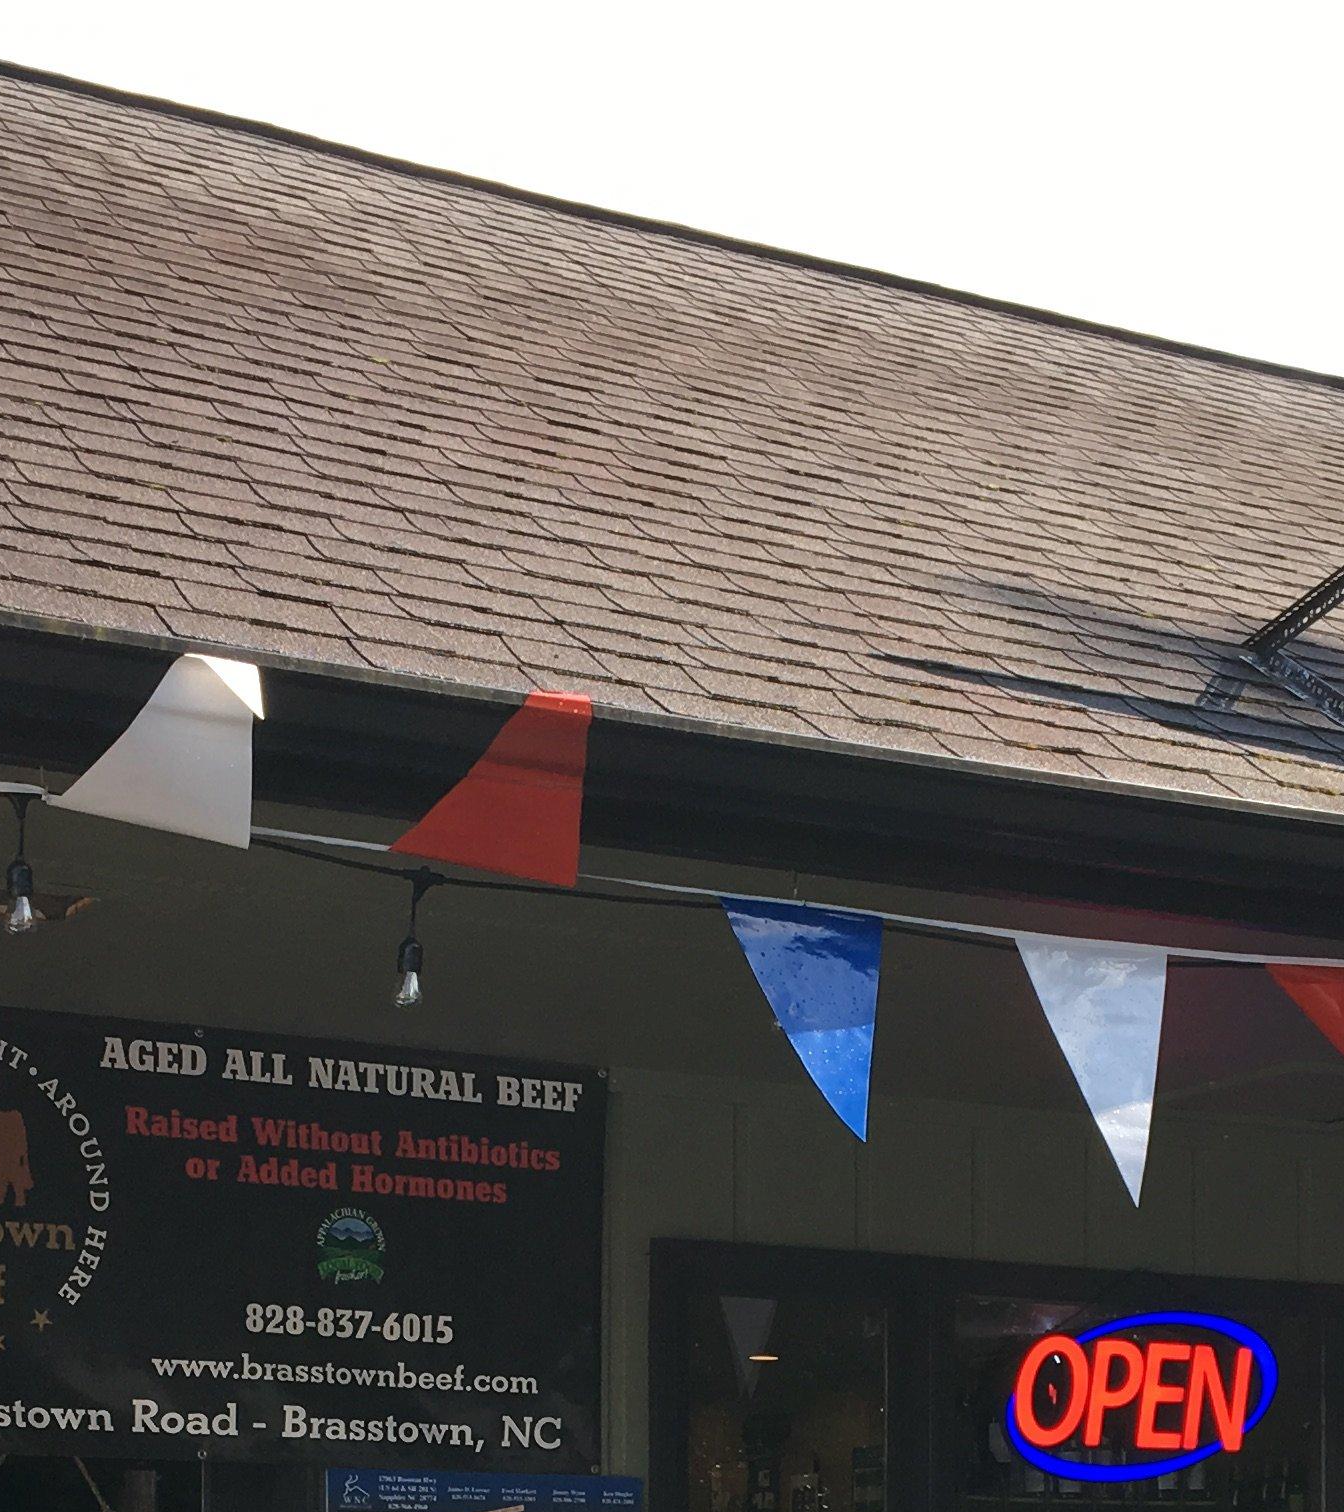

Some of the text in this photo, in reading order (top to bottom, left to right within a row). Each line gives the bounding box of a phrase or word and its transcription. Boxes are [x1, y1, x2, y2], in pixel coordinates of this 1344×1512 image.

[100, 1036, 583, 1113] AGED ALL NATURAL BEEF
[38, 1078, 111, 1212] AROUND
[125, 1105, 562, 1172] Raised Without Antibiotics
[184, 1155, 509, 1204] or Added Hormones
[58, 1225, 107, 1307] HERE
[244, 1303, 454, 1344] 828-837-6015
[151, 1352, 539, 1395] www.brasstownbeef.com
[1013, 1332, 1254, 1452] OPEN
[132, 1399, 239, 1437] Road
[281, 1404, 485, 1453] Brasstown,
[500, 1415, 563, 1451] NC
